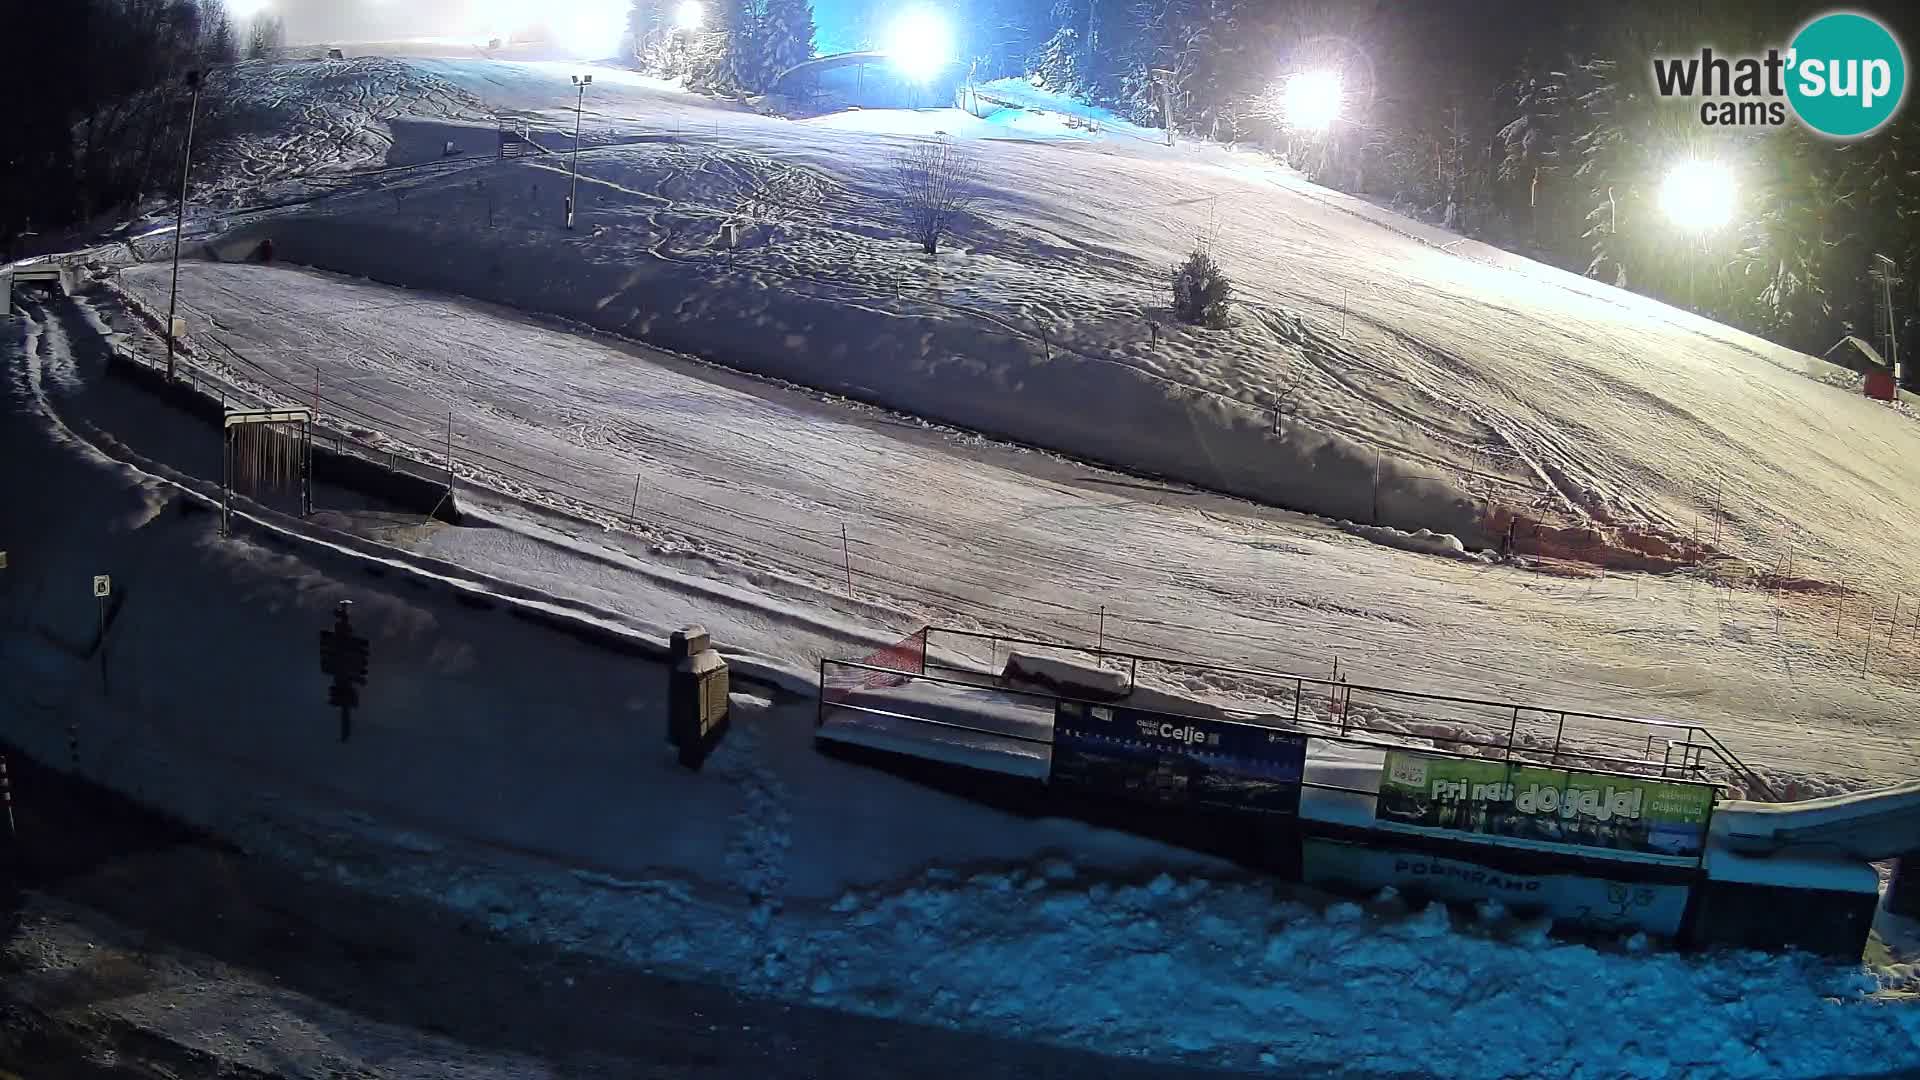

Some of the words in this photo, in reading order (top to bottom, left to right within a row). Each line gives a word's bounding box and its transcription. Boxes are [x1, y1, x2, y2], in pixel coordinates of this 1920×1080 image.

[1160, 723, 1206, 745] Celje
[1431, 778, 1468, 801] Pri
[1516, 783, 1643, 821] dogaja!
